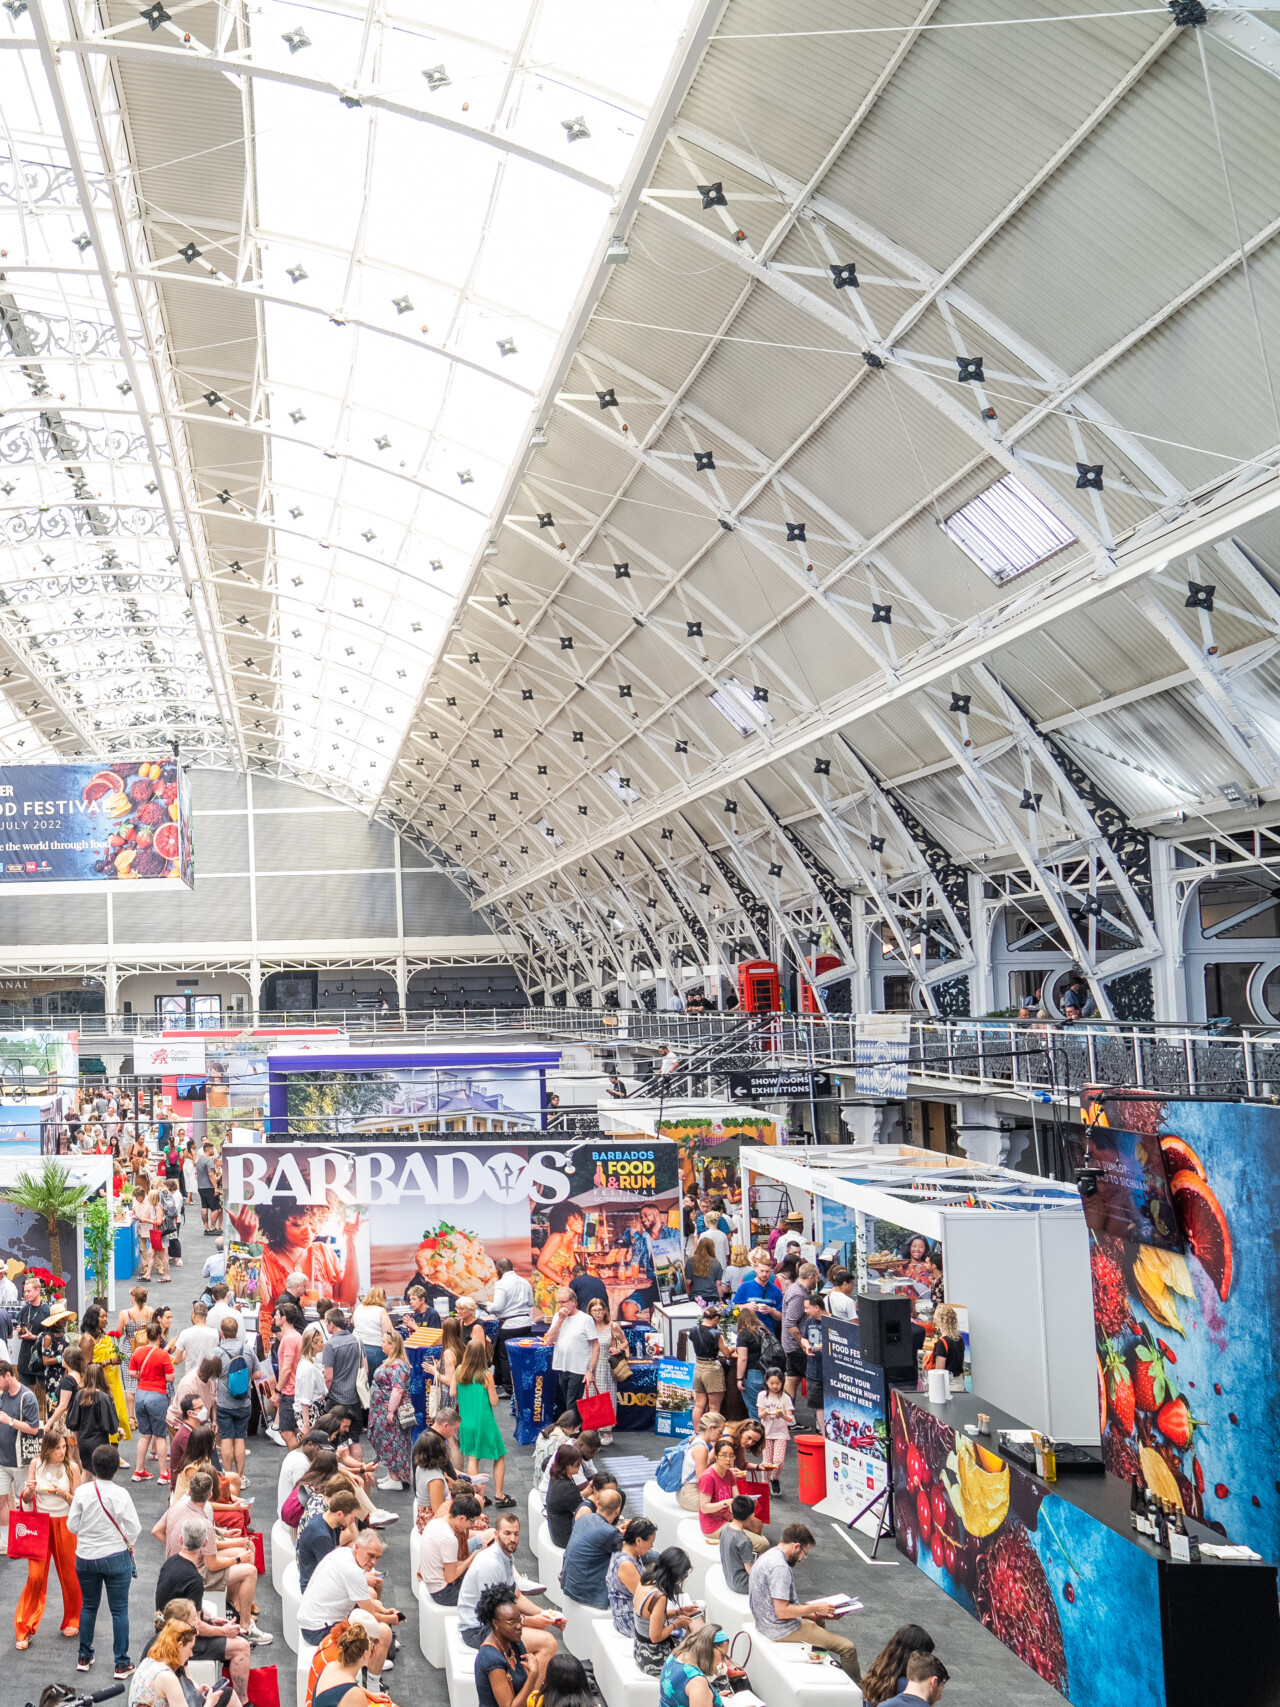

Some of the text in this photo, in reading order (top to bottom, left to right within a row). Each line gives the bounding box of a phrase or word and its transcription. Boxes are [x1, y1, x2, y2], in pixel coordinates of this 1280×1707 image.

[23, 800, 110, 816] FESTIVAL
[0, 821, 28, 831] JULY
[33, 820, 61, 829] 2022
[5, 841, 20, 851] the
[22, 841, 49, 851] world
[50, 840, 88, 853] through
[90, 839, 111, 849] food
[170, 1049, 189, 1057] Cymru
[750, 1076, 809, 1085] SHOWROOMS
[751, 1085, 810, 1094] EXHIBITIONS
[592, 1151, 655, 1160] BARBADOS
[608, 1161, 656, 1175] FOOD
[225, 1151, 570, 1205] BARBADOS
[1109, 1175, 1119, 1184] TO
[832, 1343, 849, 1354] FOOD
[838, 1372, 871, 1390] POST YOUR
[829, 1379, 880, 1402] SCAVENGER HUNT
[533, 1375, 544, 1422] BARBADOS
[838, 1390, 873, 1408] ENTRY HERE
